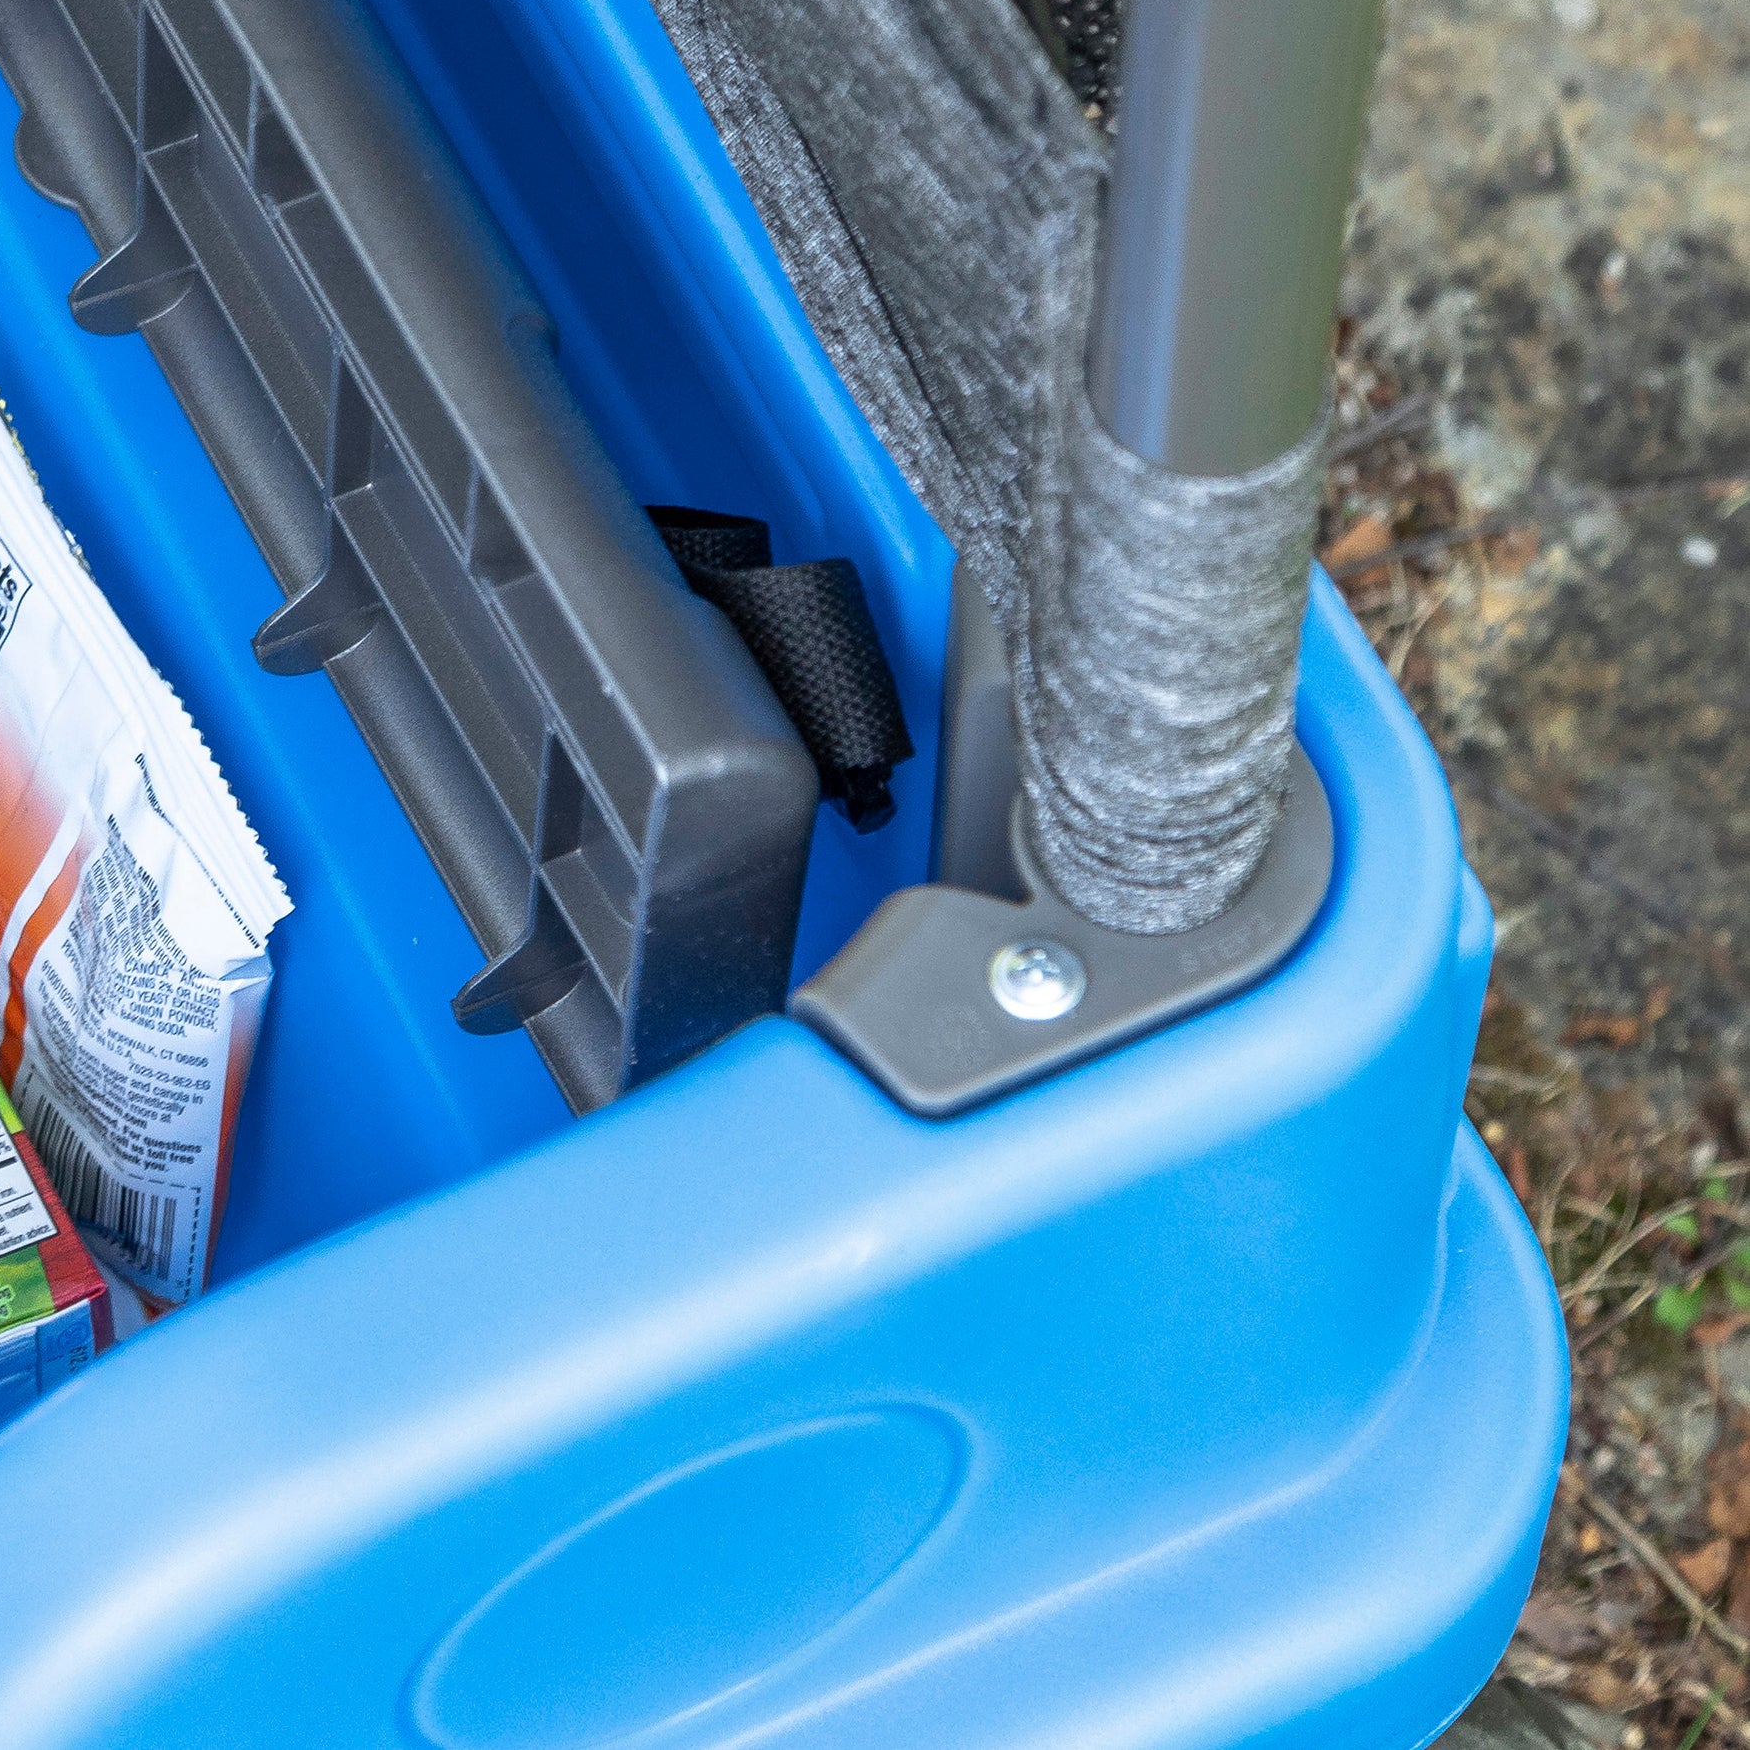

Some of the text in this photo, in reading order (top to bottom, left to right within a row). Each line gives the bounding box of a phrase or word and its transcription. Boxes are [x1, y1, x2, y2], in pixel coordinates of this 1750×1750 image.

[137, 991, 169, 1005] YEAST
[177, 986, 191, 999] OR
[193, 992, 220, 1008] LESS
[130, 1001, 163, 1018] ONION
[160, 1049, 174, 1060] CT
[130, 1079, 151, 1092] and
[152, 1086, 190, 1103] canola
[143, 1136, 202, 1154] questions
